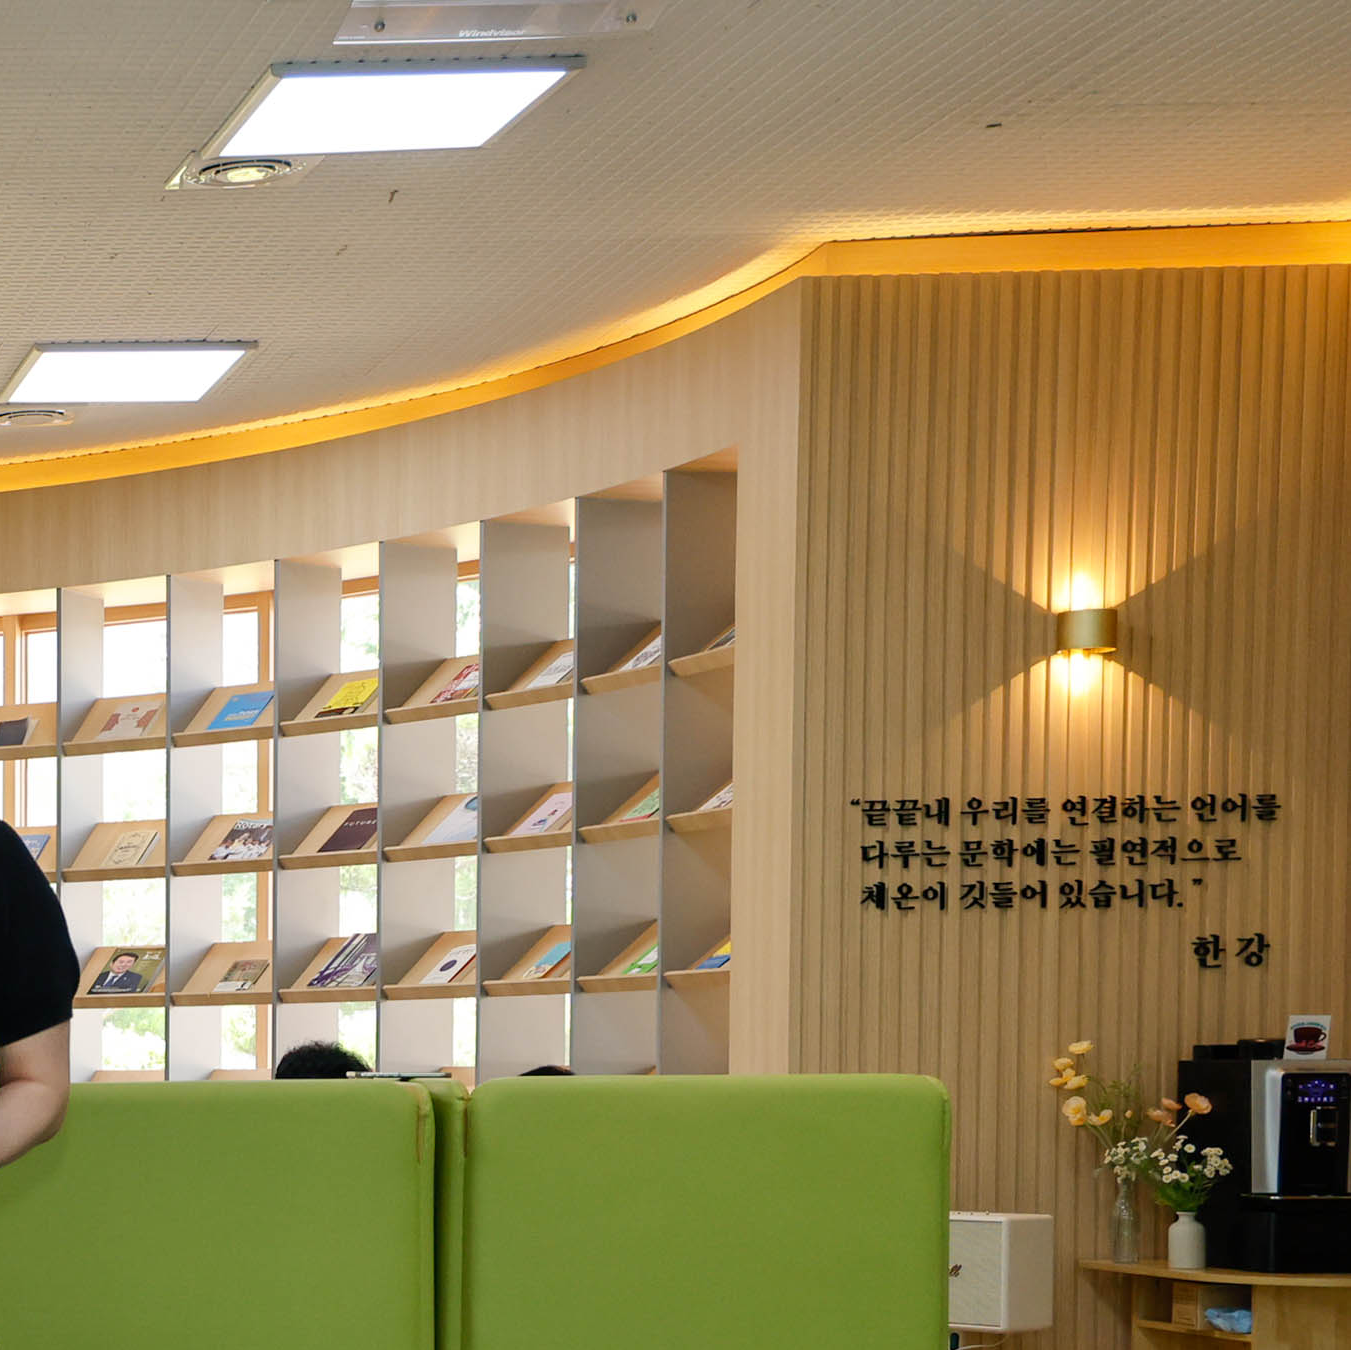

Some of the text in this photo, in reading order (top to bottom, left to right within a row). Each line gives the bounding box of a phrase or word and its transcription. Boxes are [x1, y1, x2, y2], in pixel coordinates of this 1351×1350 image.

[959, 797, 1051, 827] 우리를
[1061, 795, 1181, 827] 연결하는
[1190, 793, 1282, 823] 언어를
[859, 836, 1242, 869] 다루는 문학에는 필연적으로
[859, 880, 948, 911] 체온이
[958, 880, 1049, 910] 깃들어
